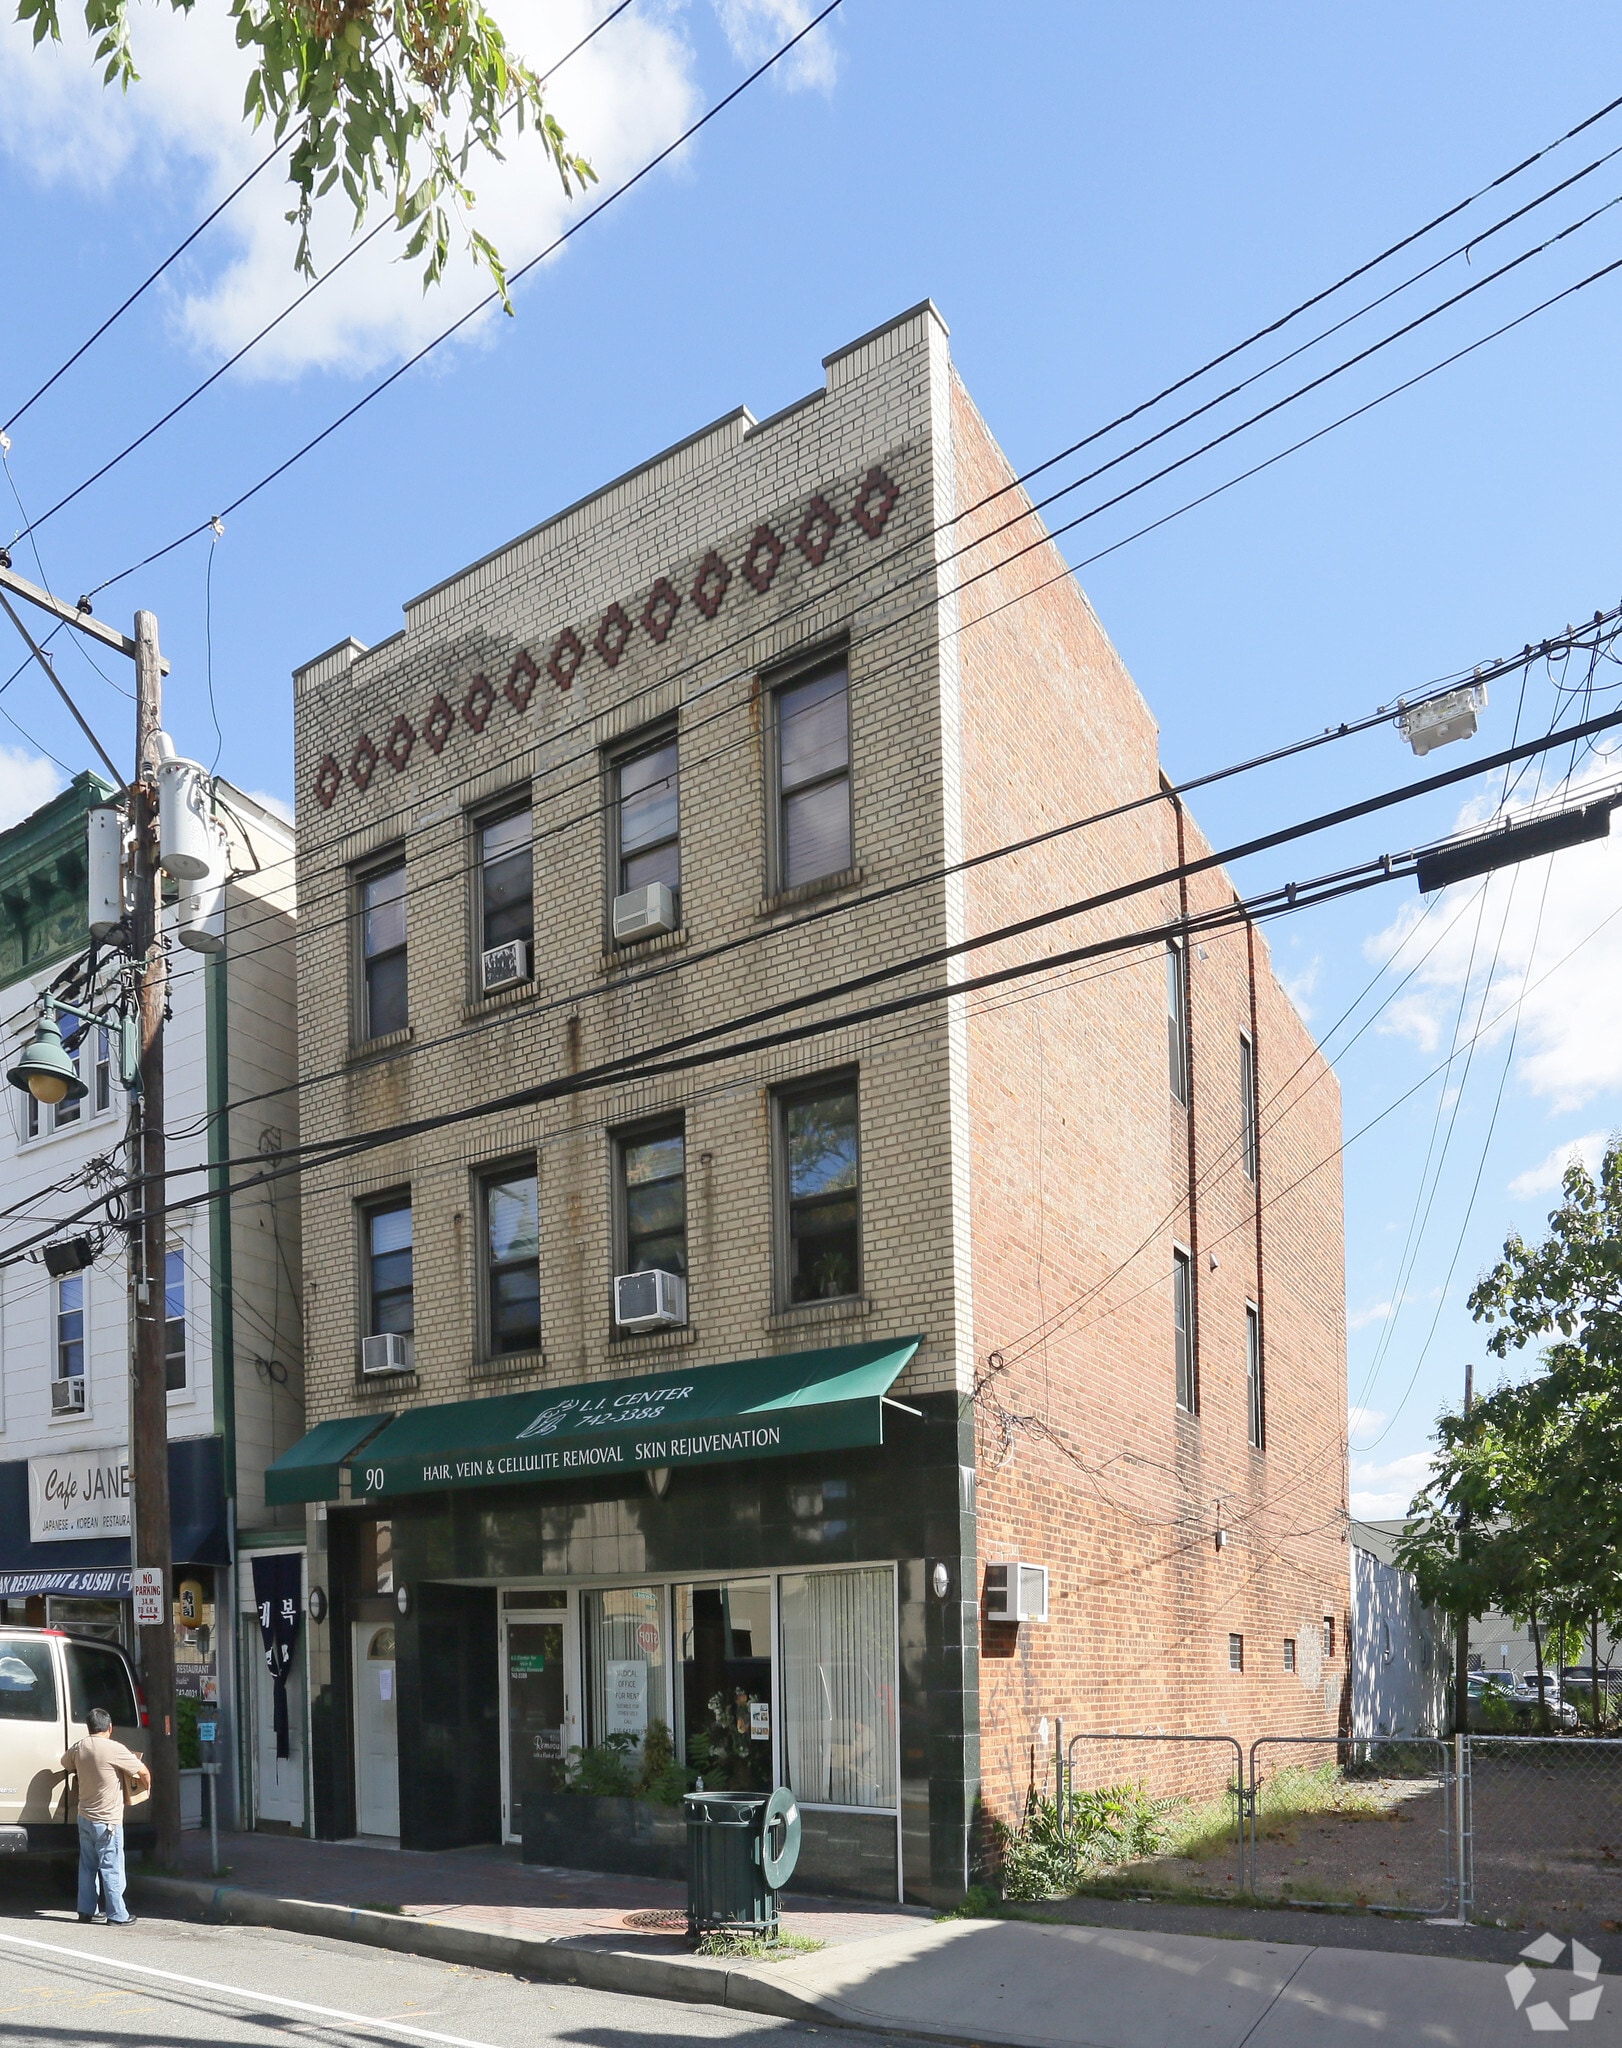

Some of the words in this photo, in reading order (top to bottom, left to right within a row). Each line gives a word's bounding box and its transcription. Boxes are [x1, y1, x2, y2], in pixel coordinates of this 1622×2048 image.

[580, 1398, 605, 1412] L.I.
[613, 1386, 694, 1407] CENTER
[574, 1406, 665, 1428] 742-3388
[423, 1464, 453, 1481] HAIR,
[456, 1461, 483, 1477] VEIN
[486, 1460, 494, 1475] &
[498, 1452, 559, 1474] CELLULITE
[563, 1445, 624, 1467] REMOVAL
[635, 1441, 666, 1460] SKIN
[671, 1427, 780, 1456] REJUVENATION
[45, 1468, 78, 1510] Cafe
[83, 1465, 130, 1501] JANE
[366, 1468, 384, 1491] 90
[42, 1519, 69, 1531] JAPANESE
[76, 1517, 99, 1529] KOREAN
[103, 1514, 131, 1528] RESTAURA
[10, 1573, 71, 1593] RESTAURANT
[68, 1574, 79, 1590] &
[79, 1573, 116, 1592] SUSHI
[143, 1574, 153, 1584] NO
[136, 1585, 161, 1596] PARKING
[176, 1664, 209, 1674] RESTAURANT
[618, 1681, 636, 1689] OFFICE
[615, 1692, 626, 1700] FOR
[627, 1692, 640, 1700] RENT
